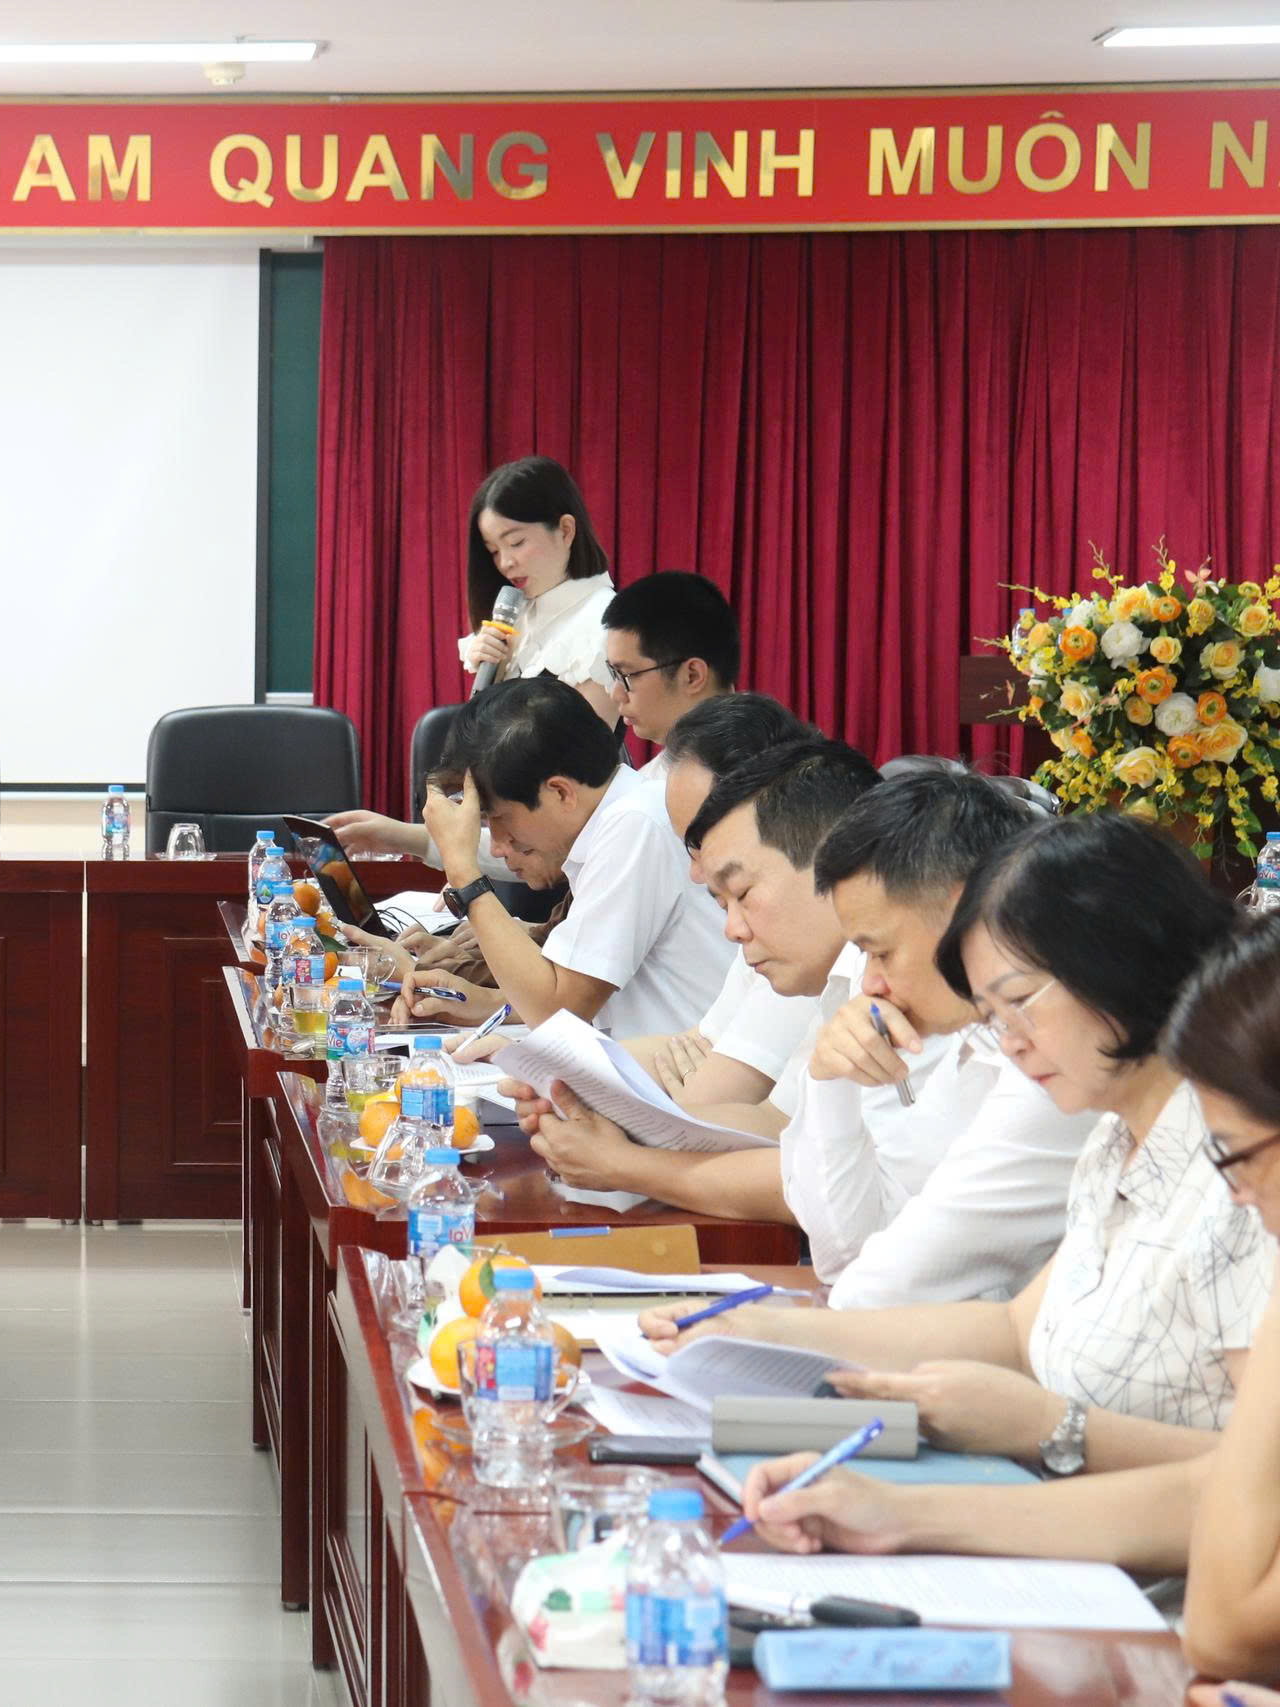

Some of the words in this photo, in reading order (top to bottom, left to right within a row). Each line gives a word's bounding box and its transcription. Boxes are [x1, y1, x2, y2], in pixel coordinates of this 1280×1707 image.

[208, 132, 549, 208] QUANG
[595, 128, 816, 199] VINH
[867, 110, 1153, 196] MUÔN
[1209, 119, 1280, 189] N
